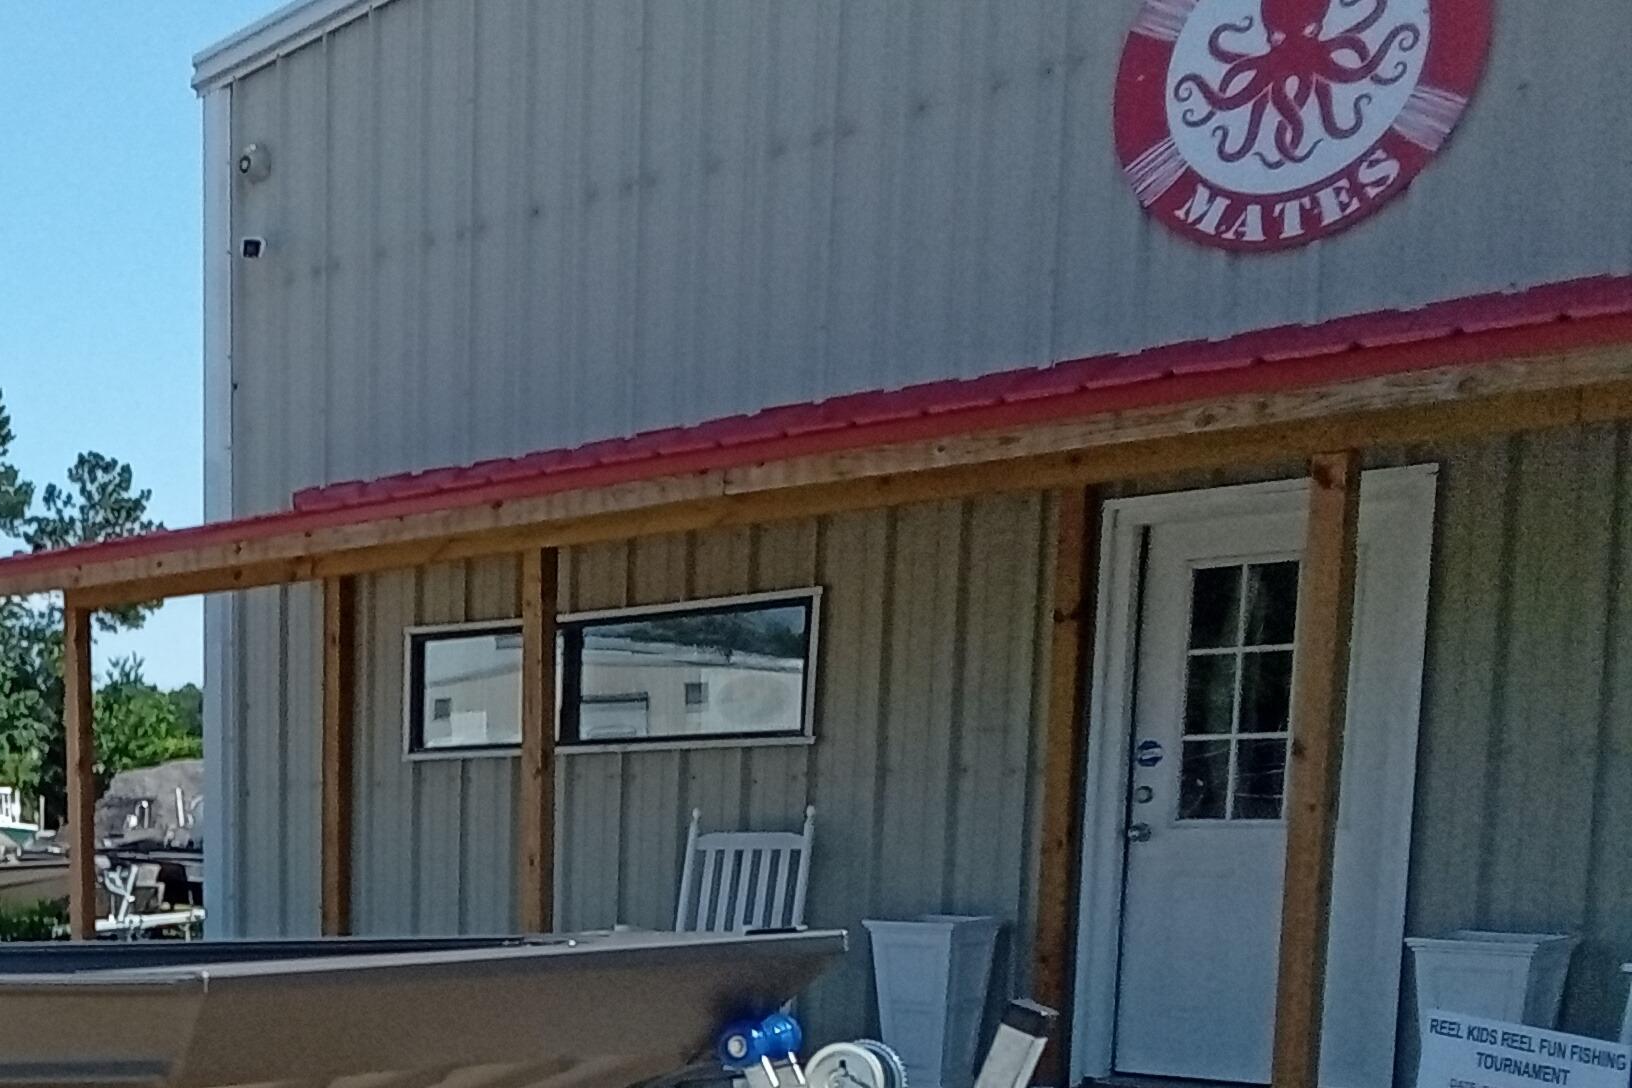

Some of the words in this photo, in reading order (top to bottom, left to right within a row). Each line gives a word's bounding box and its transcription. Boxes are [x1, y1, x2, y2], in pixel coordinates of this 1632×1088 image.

[1174, 148, 1400, 241] MATES
[1430, 1018, 1463, 1038] REEL
[1466, 1024, 1497, 1045] KIDS
[1501, 1030, 1535, 1052] REEL
[1539, 1039, 1566, 1059] FUN
[1570, 1045, 1626, 1070] FISHING
[1476, 1052, 1570, 1085] TOURNAMENT
